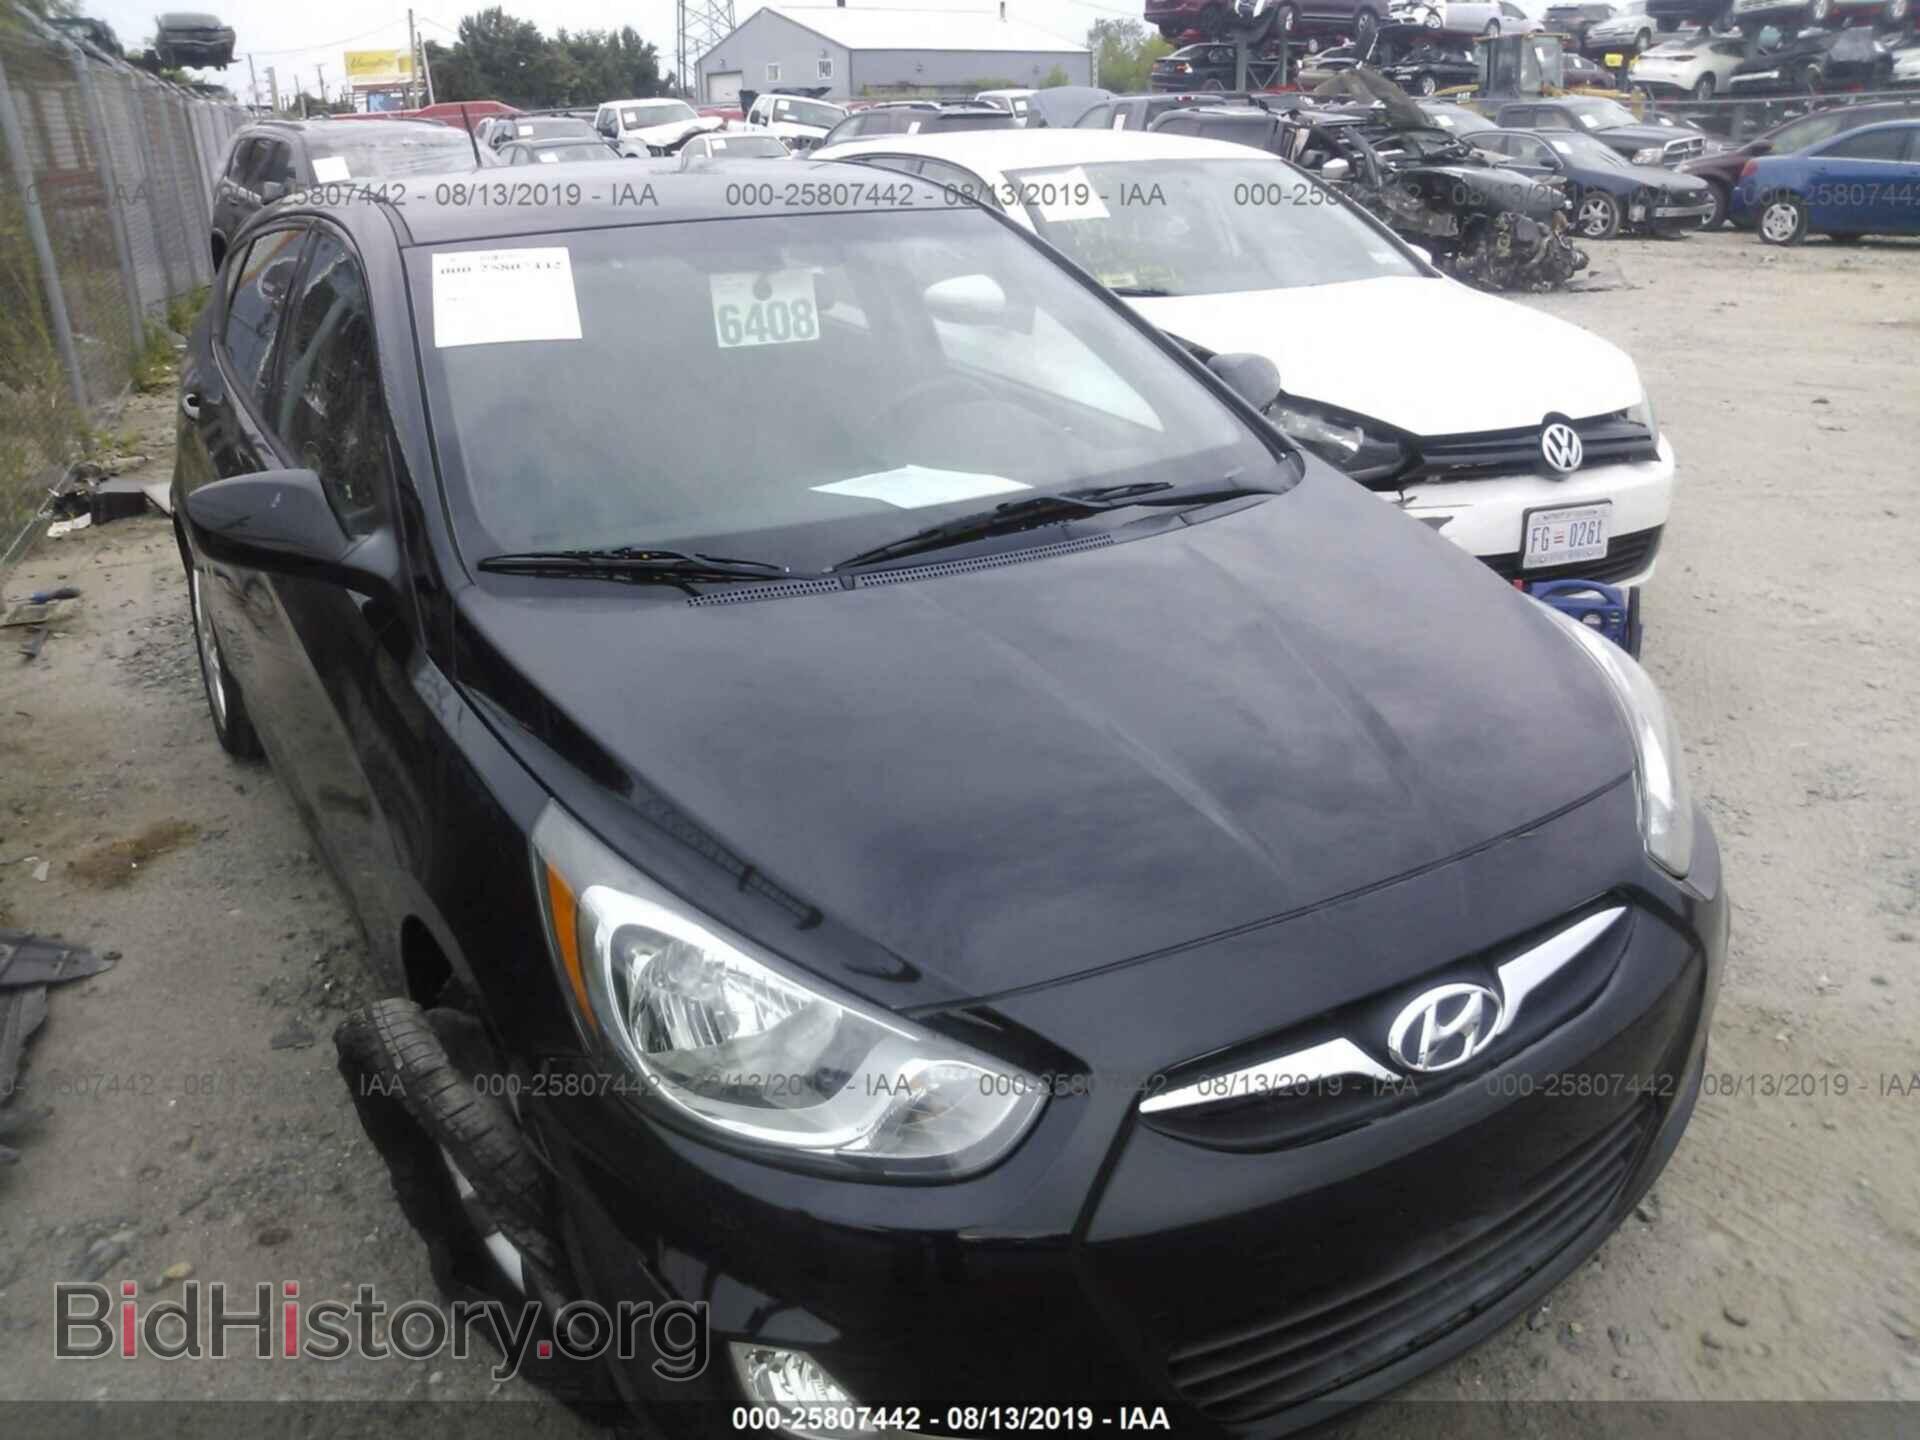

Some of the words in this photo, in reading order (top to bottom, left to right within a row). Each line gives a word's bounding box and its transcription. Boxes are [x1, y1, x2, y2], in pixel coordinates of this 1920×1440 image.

[718, 297, 818, 345] 6408
[1531, 526, 1551, 552] FG
[1569, 520, 1602, 548] 0261
